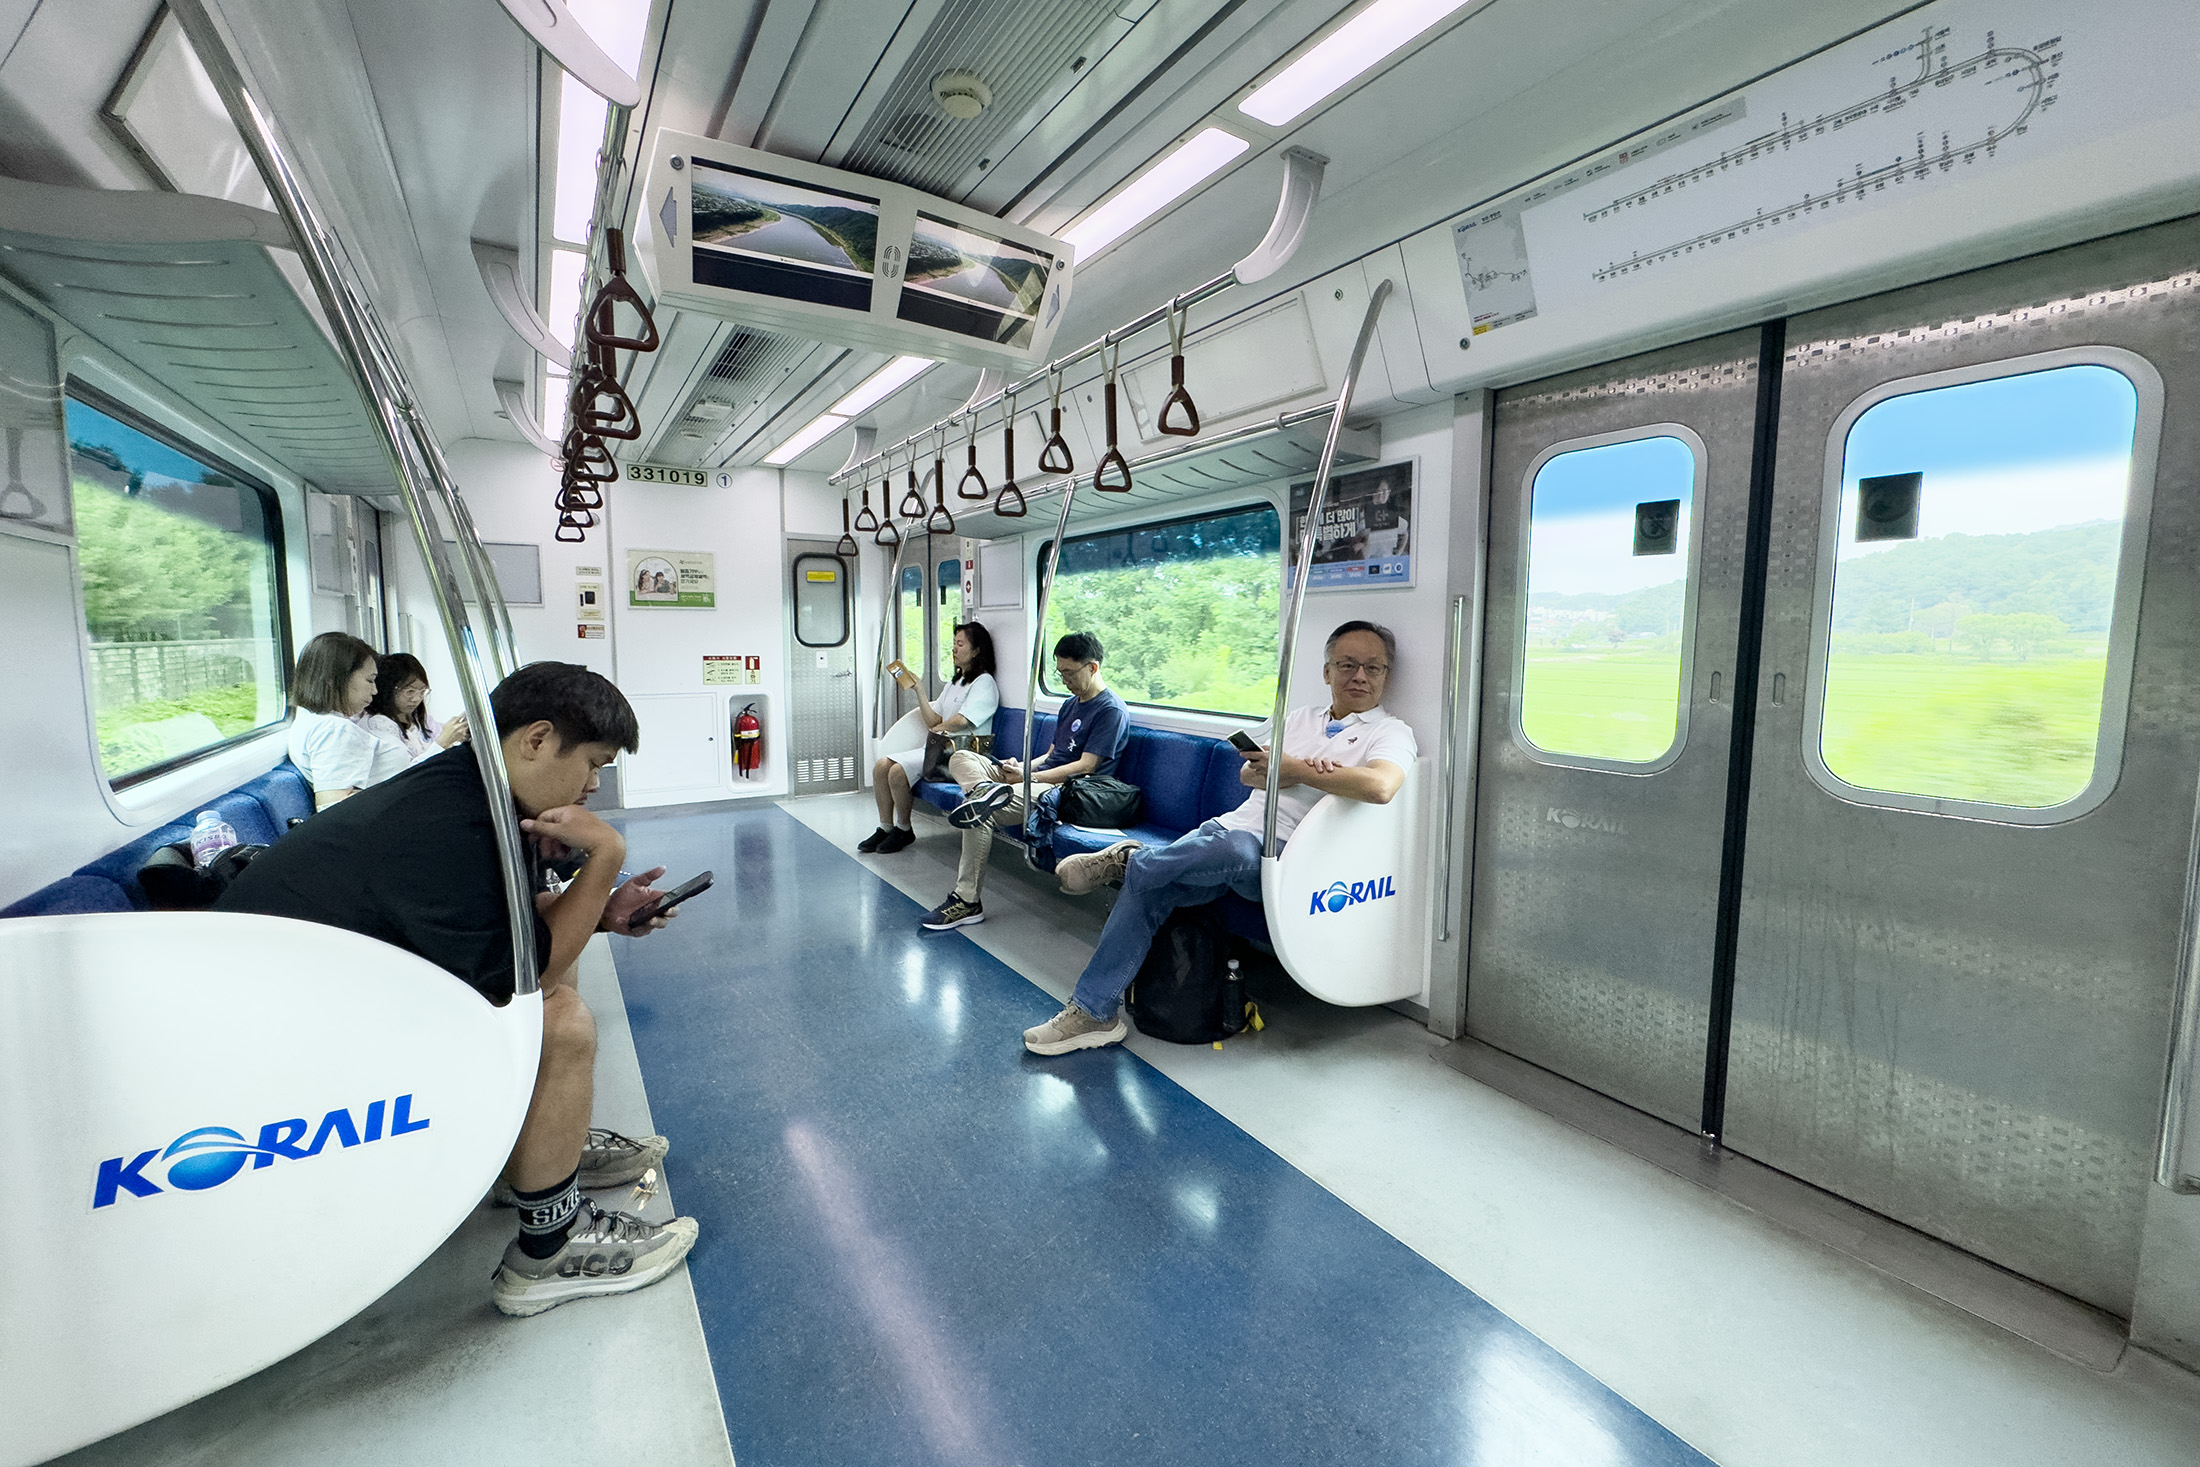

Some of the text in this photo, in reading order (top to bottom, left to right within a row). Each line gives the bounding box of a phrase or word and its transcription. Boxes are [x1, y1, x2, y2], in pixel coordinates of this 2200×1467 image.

[630, 466, 705, 485] 331019
[1337, 507, 1355, 523] 많이
[1309, 875, 1396, 916] KORAIL
[93, 1093, 431, 1209] KORAIL
